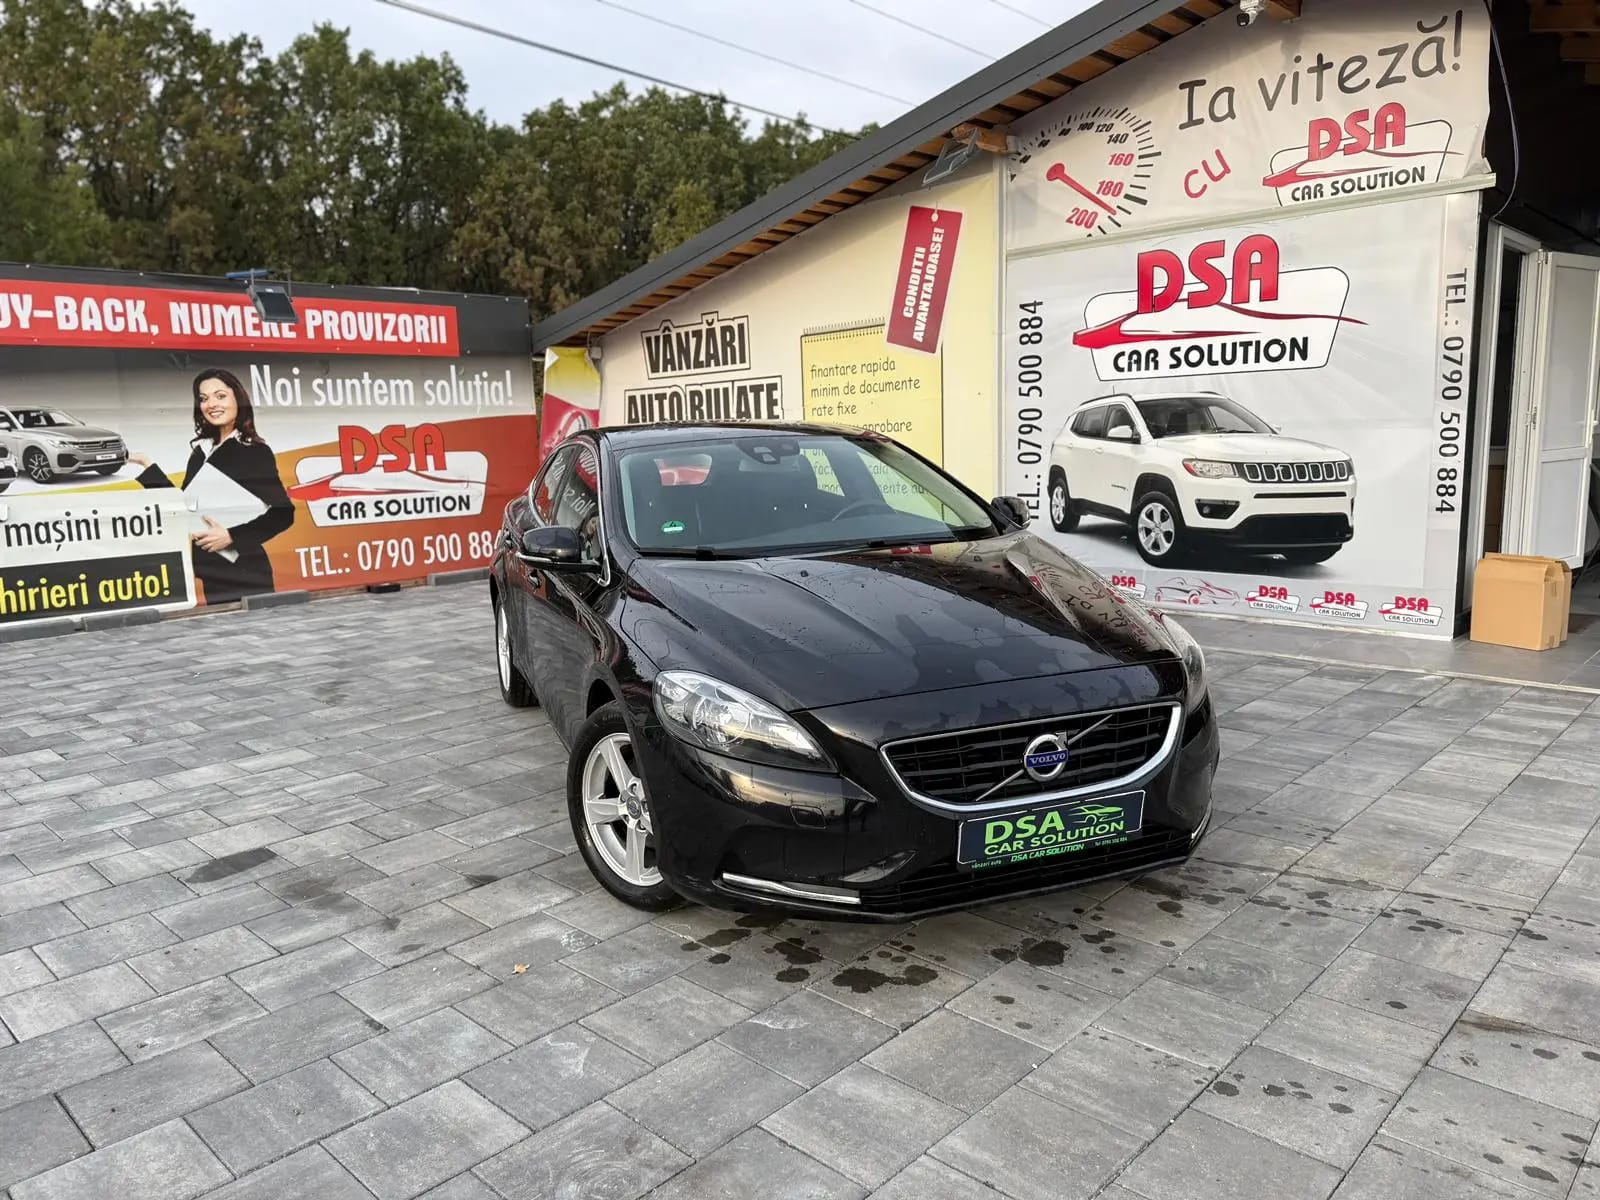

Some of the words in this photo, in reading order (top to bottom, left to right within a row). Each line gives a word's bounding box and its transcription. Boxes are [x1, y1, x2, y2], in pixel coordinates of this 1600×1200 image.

[1178, 79, 1236, 130] Ia
[1257, 10, 1463, 111] viteză!
[1095, 122, 1115, 134] 120
[1107, 133, 1129, 144] 140
[1308, 102, 1406, 161] DSA
[1108, 153, 1134, 166] 160
[1184, 149, 1231, 199] cu
[1096, 180, 1125, 197] 180
[1291, 183, 1324, 202] CAR
[1330, 165, 1425, 196] SOLUTION
[1065, 207, 1099, 229] 200
[1137, 234, 1279, 314] DSA
[1444, 268, 1467, 326] TEL.:
[305, 308, 447, 344] PROVIZORII
[1019, 300, 1043, 345] 884
[645, 319, 746, 374] VÂNZĂRI
[1113, 349, 1159, 372] CAR
[1169, 336, 1309, 368] SOLUTION
[810, 364, 857, 380] finantare
[861, 357, 896, 376] rapida
[1018, 355, 1043, 398] 500
[1441, 336, 1464, 400] 0790
[250, 364, 301, 407] Noi
[312, 371, 414, 407] suntem
[423, 364, 513, 414] soluția!
[811, 384, 840, 398] minim
[843, 381, 856, 396] de
[859, 377, 921, 394] documente
[811, 404, 833, 417] rate
[837, 401, 857, 416] fixe
[338, 423, 447, 474] DSA
[1017, 407, 1043, 464] 0790
[1438, 411, 1460, 458] 500
[327, 501, 366, 520] CAR
[374, 494, 471, 517] SOLUTION
[1435, 467, 1458, 513] 884
[4, 509, 101, 551] mașini
[112, 504, 163, 538] noi!
[295, 545, 351, 578] TEL.:
[357, 536, 415, 571] 0790
[423, 532, 462, 564] 500
[98, 563, 170, 603] auto!
[1112, 575, 1136, 587] DSA
[1258, 585, 1288, 600] DSA
[1324, 591, 1355, 606] DSA
[1394, 596, 1429, 611] DSA
[1030, 752, 1066, 764] VOLVO
[984, 810, 1065, 844] DSA
[984, 840, 1024, 855] CAR
[1030, 820, 1125, 848] SOLUTION
[1011, 854, 1028, 863] DSA
[1029, 850, 1046, 860] CAR
[1045, 843, 1085, 856] SOLUTION
